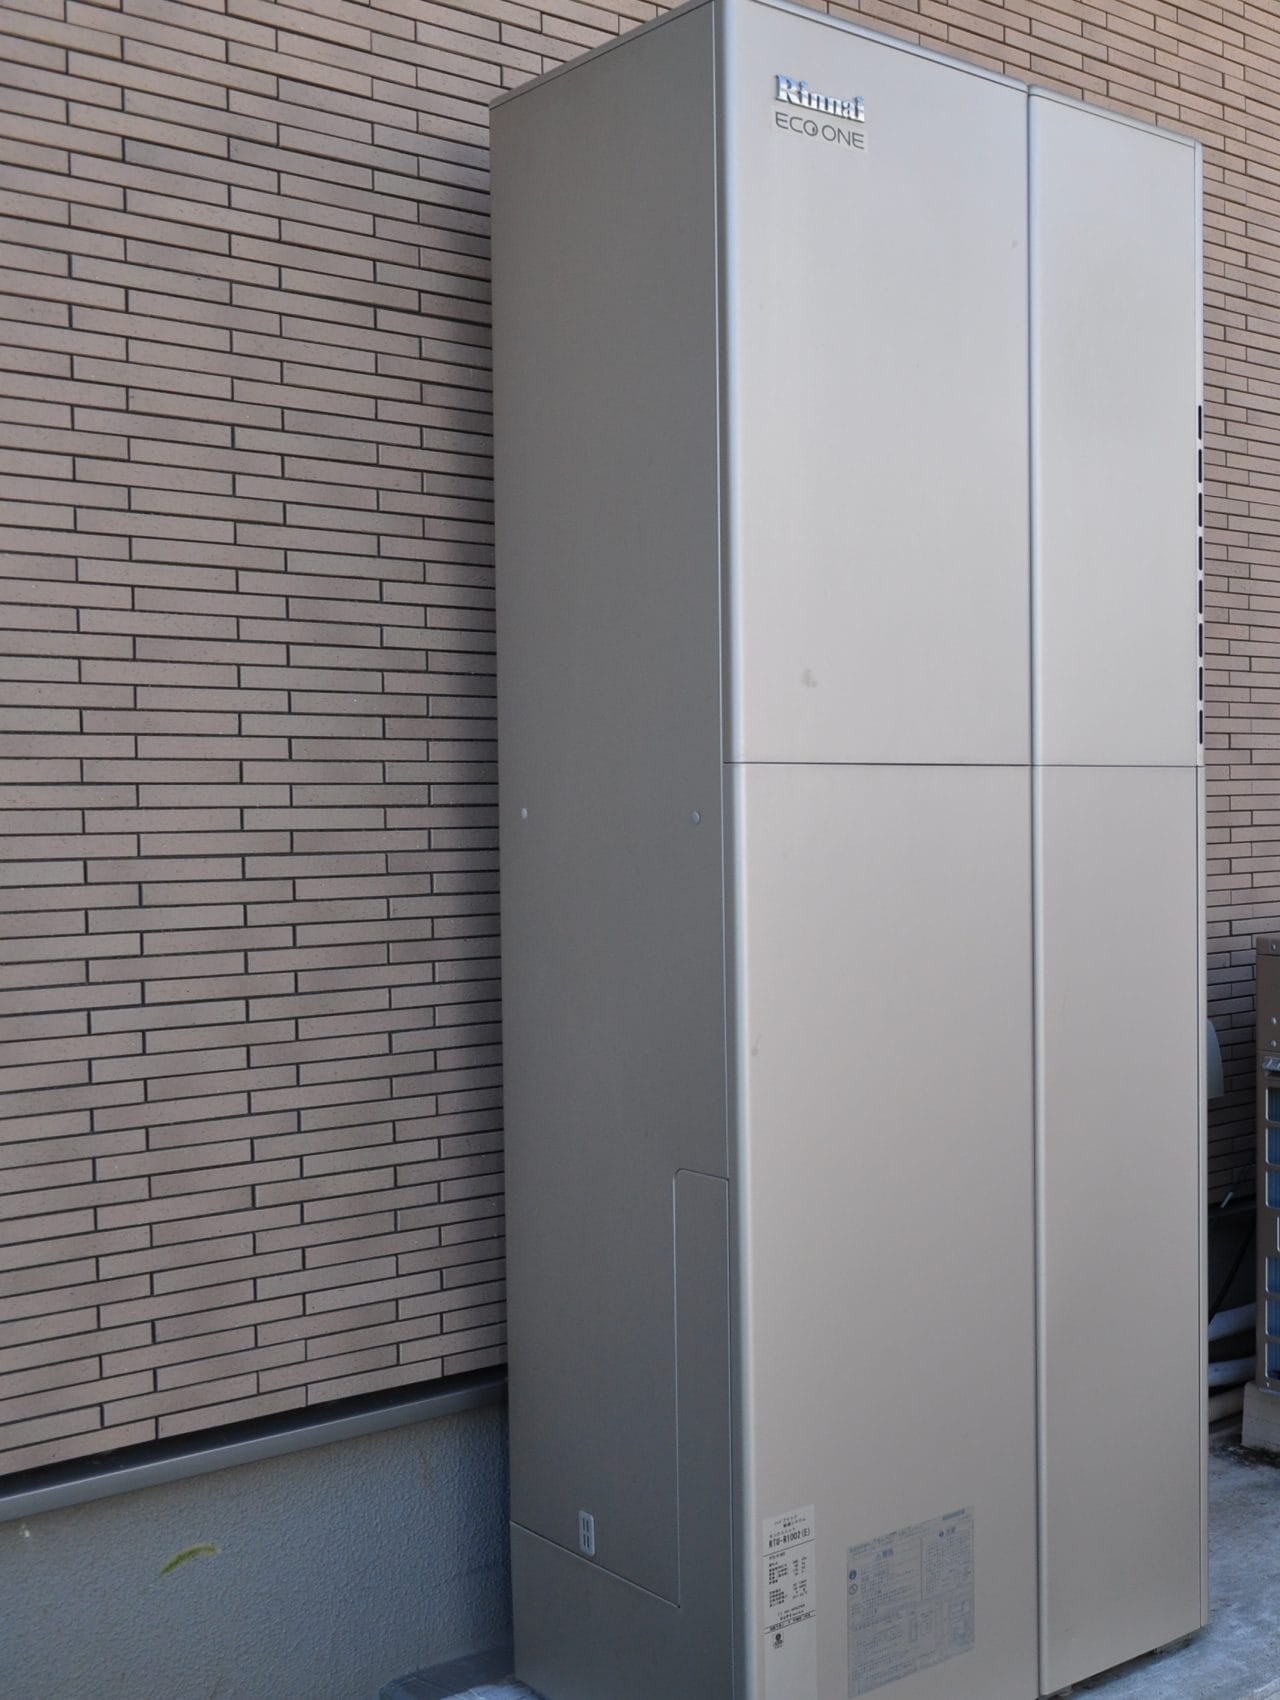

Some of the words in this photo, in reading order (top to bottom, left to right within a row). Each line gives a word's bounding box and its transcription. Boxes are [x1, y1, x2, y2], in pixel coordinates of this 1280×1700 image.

[774, 73, 865, 122] Rinnai
[775, 111, 818, 137] ECO
[821, 124, 864, 149] ONE
